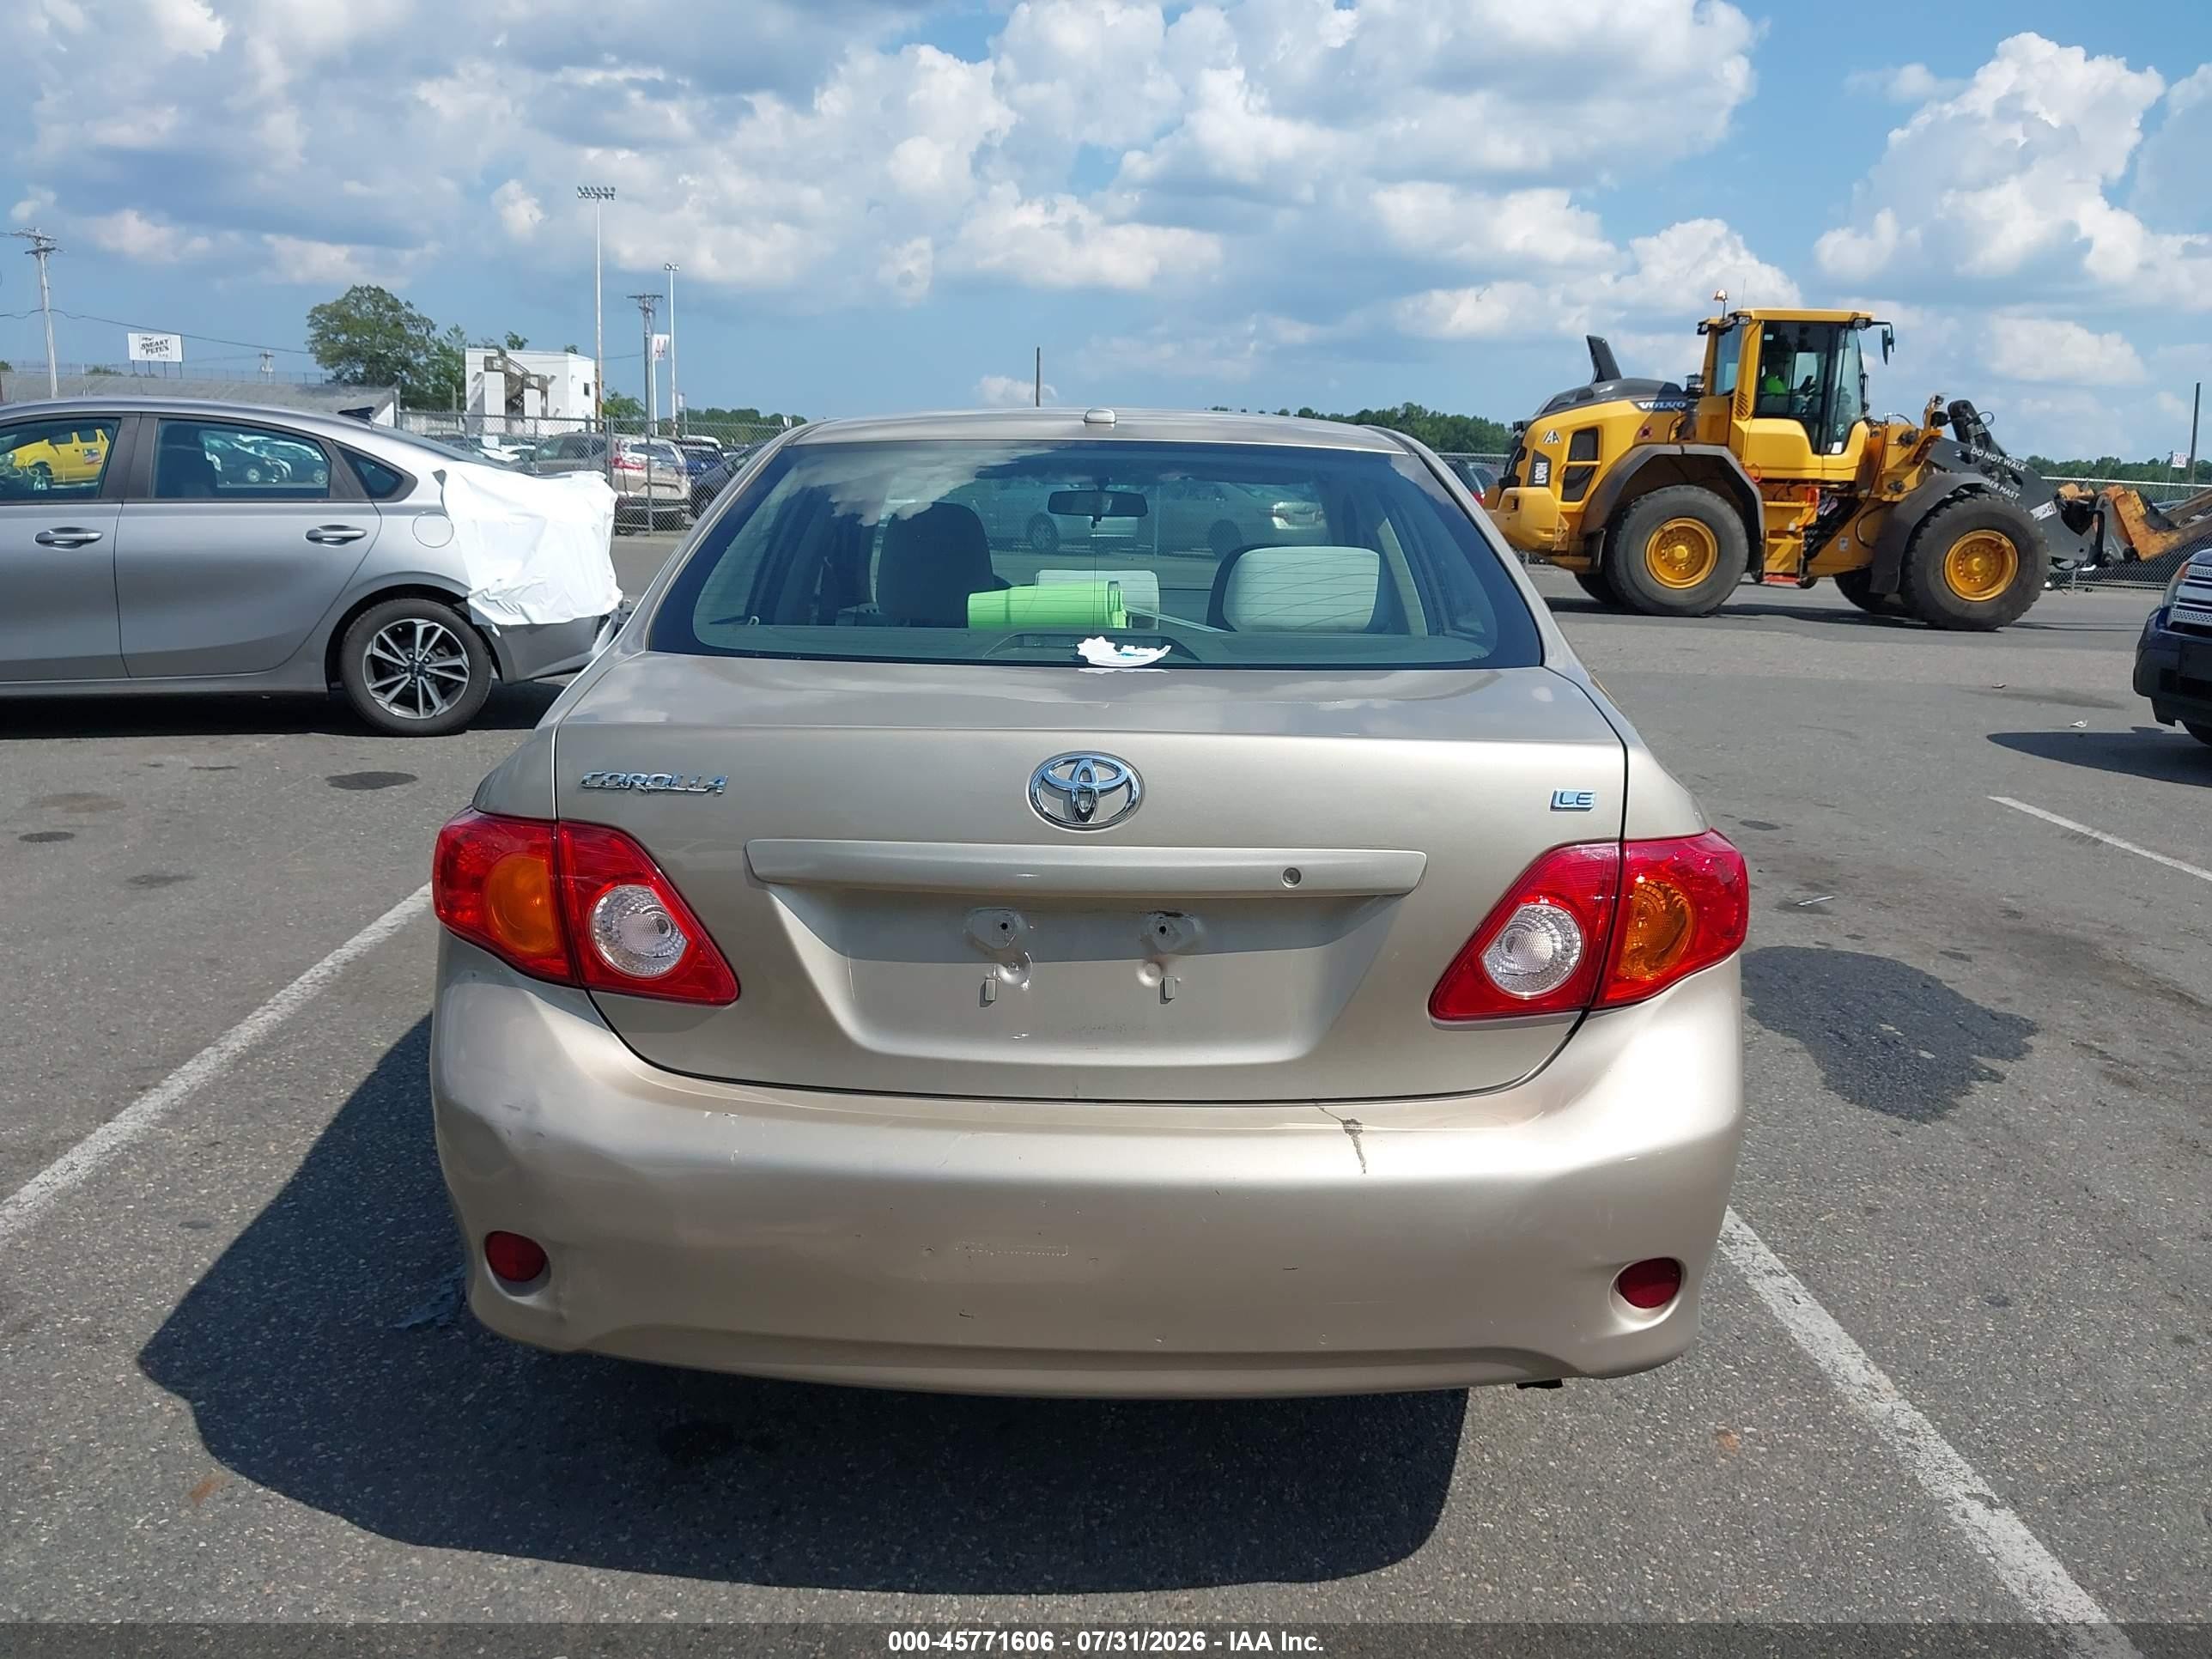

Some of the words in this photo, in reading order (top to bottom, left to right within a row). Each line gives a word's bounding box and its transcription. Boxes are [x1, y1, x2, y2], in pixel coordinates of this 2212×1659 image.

[1970, 447, 1984, 456] DO
[1984, 453, 2003, 463] NOT
[2003, 457, 2027, 472] WALK
[1999, 485, 2020, 500] MAST
[580, 771, 728, 793] COROLLA
[1549, 788, 1595, 812] LE
